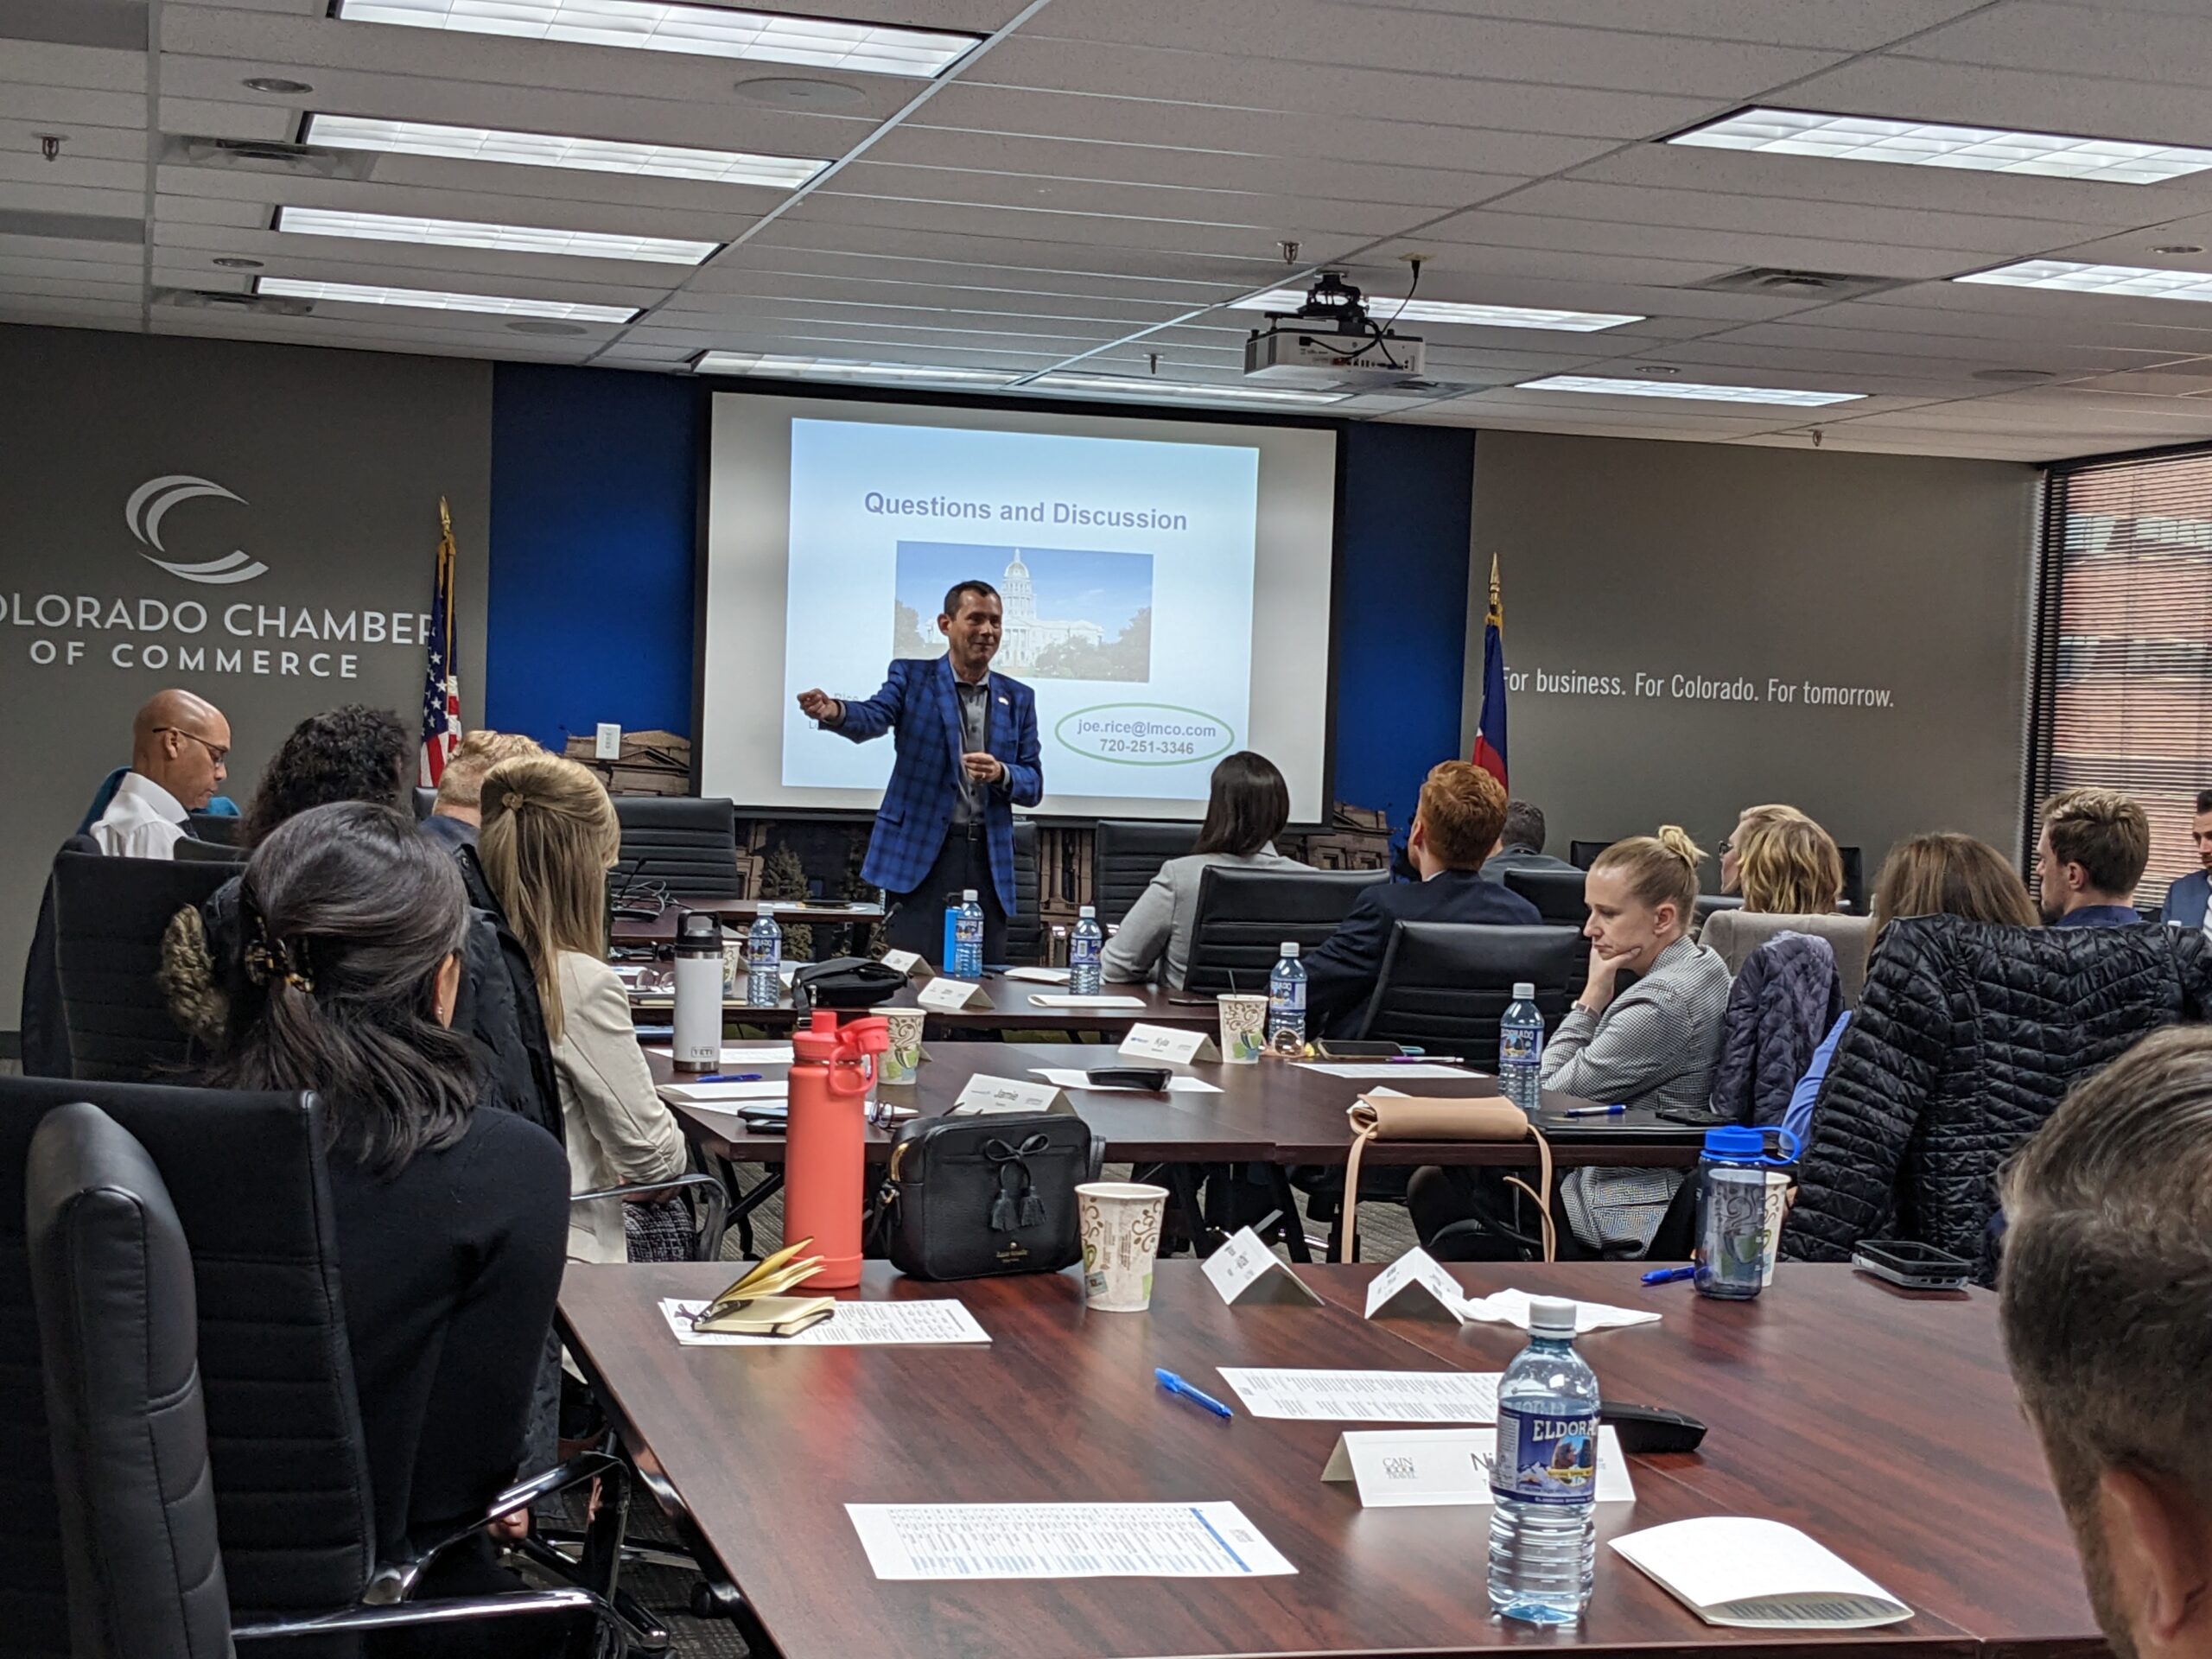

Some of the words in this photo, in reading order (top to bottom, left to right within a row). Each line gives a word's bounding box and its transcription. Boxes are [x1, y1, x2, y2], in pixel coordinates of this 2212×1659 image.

[864, 492, 991, 519] Questions
[1000, 501, 1045, 523] and
[1053, 502, 1187, 531] Discussion
[0, 593, 207, 633] LORADO
[30, 640, 86, 665] OF
[111, 642, 358, 678] COMMERCE
[1536, 668, 1626, 696] business.
[1635, 672, 1664, 697] For
[1671, 674, 1759, 702] Colorado.
[1768, 678, 1797, 702] For
[1802, 681, 1894, 708] tomorrow.
[1077, 719, 1217, 738] joe.rice@lmco.com
[1099, 738, 1194, 755] 720-251-3346
[1382, 1457, 1414, 1467] CAIN
